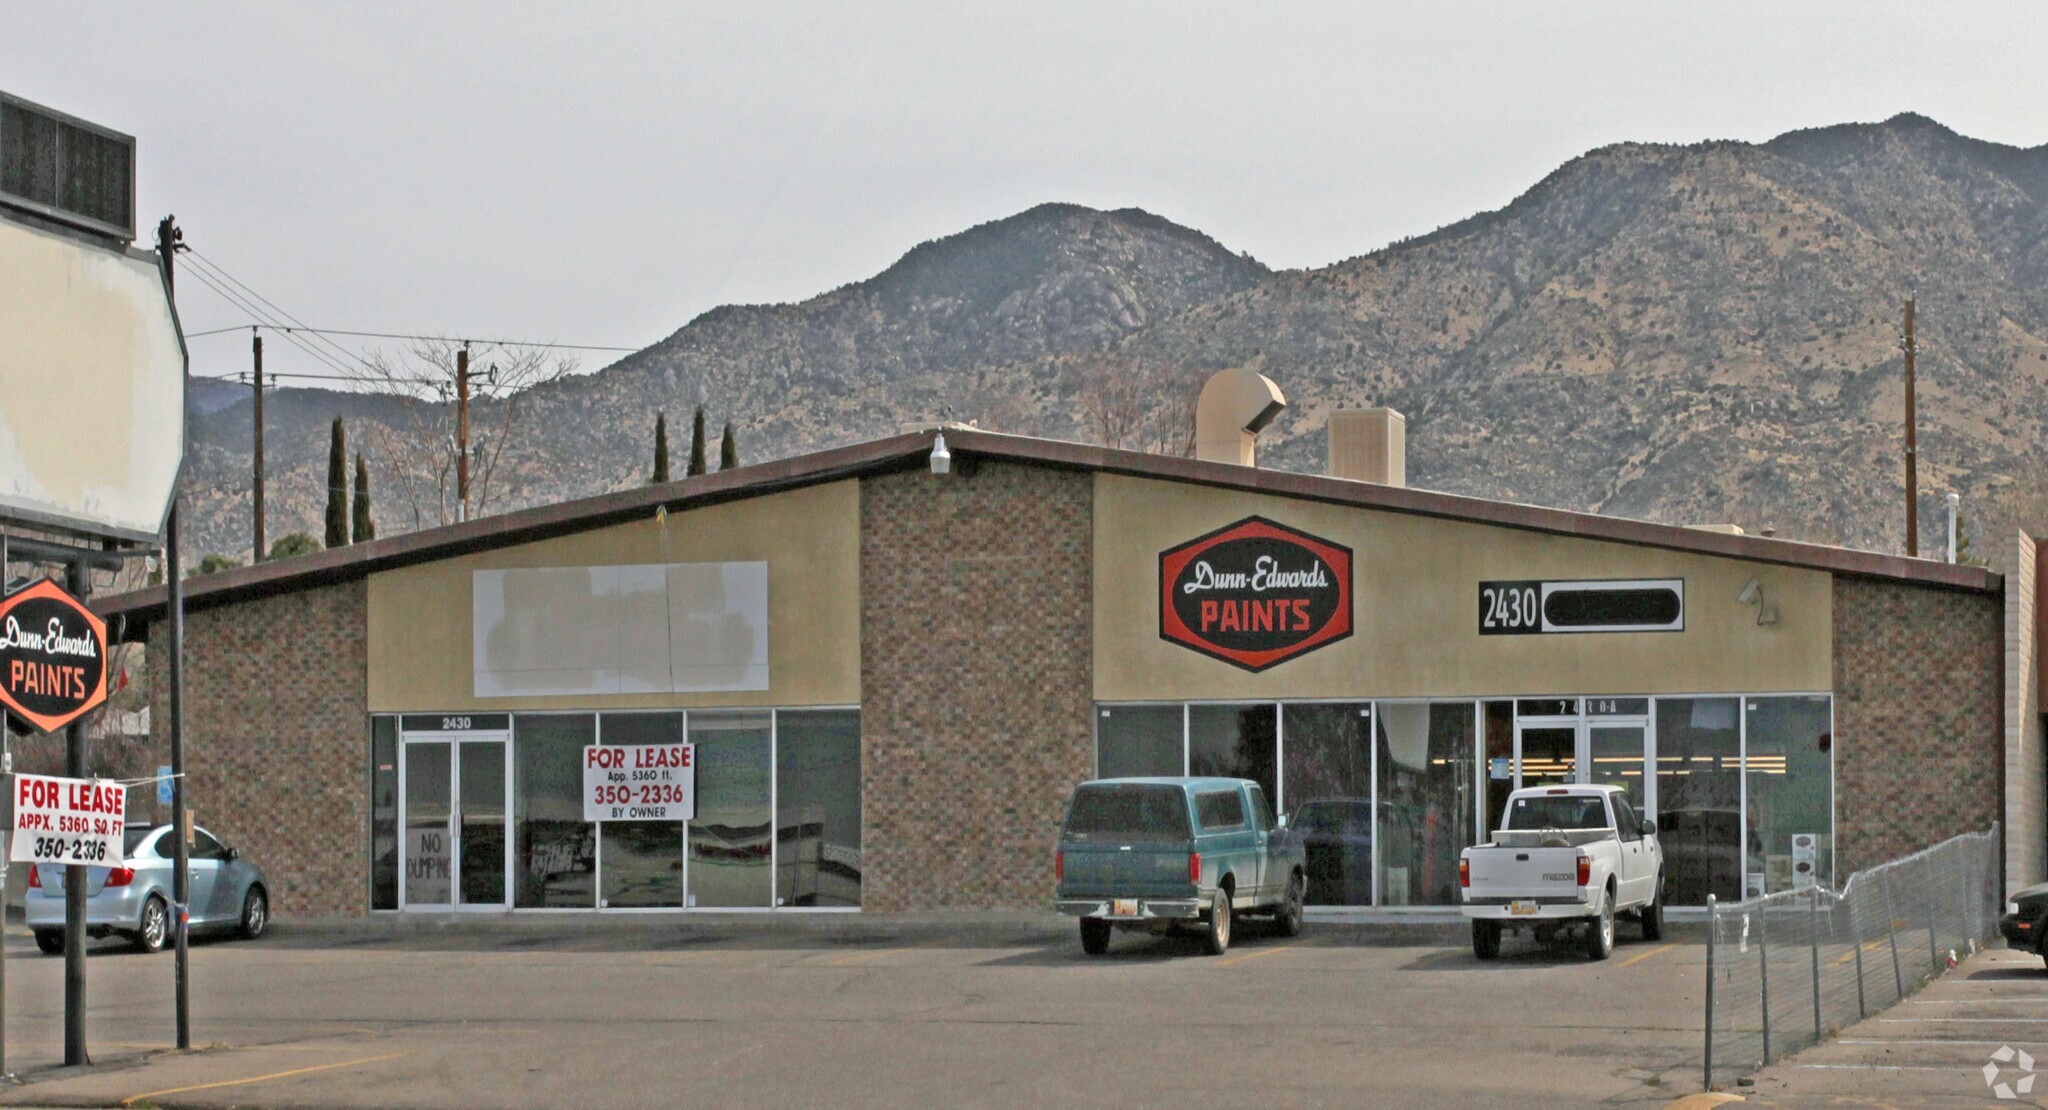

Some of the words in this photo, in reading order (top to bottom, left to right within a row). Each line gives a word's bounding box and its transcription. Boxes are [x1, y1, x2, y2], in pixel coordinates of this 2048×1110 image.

[1183, 555, 1328, 594] Dunn-Edwards
[1201, 600, 1311, 632] PAINTS
[1483, 588, 1537, 628] 2430
[11, 660, 85, 699] PAINTS
[442, 717, 472, 729] 2430
[588, 748, 626, 769] FOR
[635, 747, 690, 769] LEASE
[608, 771, 628, 783] App.
[632, 770, 658, 781] 5360
[662, 770, 673, 780] ft.
[20, 779, 60, 809] FOR
[69, 783, 123, 815] LEASE
[594, 784, 684, 804] 350-2336
[612, 808, 625, 818] BY
[629, 807, 667, 818] OWNER
[19, 813, 54, 831] APPX.
[60, 816, 89, 833] 5360
[94, 818, 109, 835] SQ.
[112, 820, 123, 836] FT
[34, 837, 106, 862] 350-2336
[421, 834, 442, 853] NO
